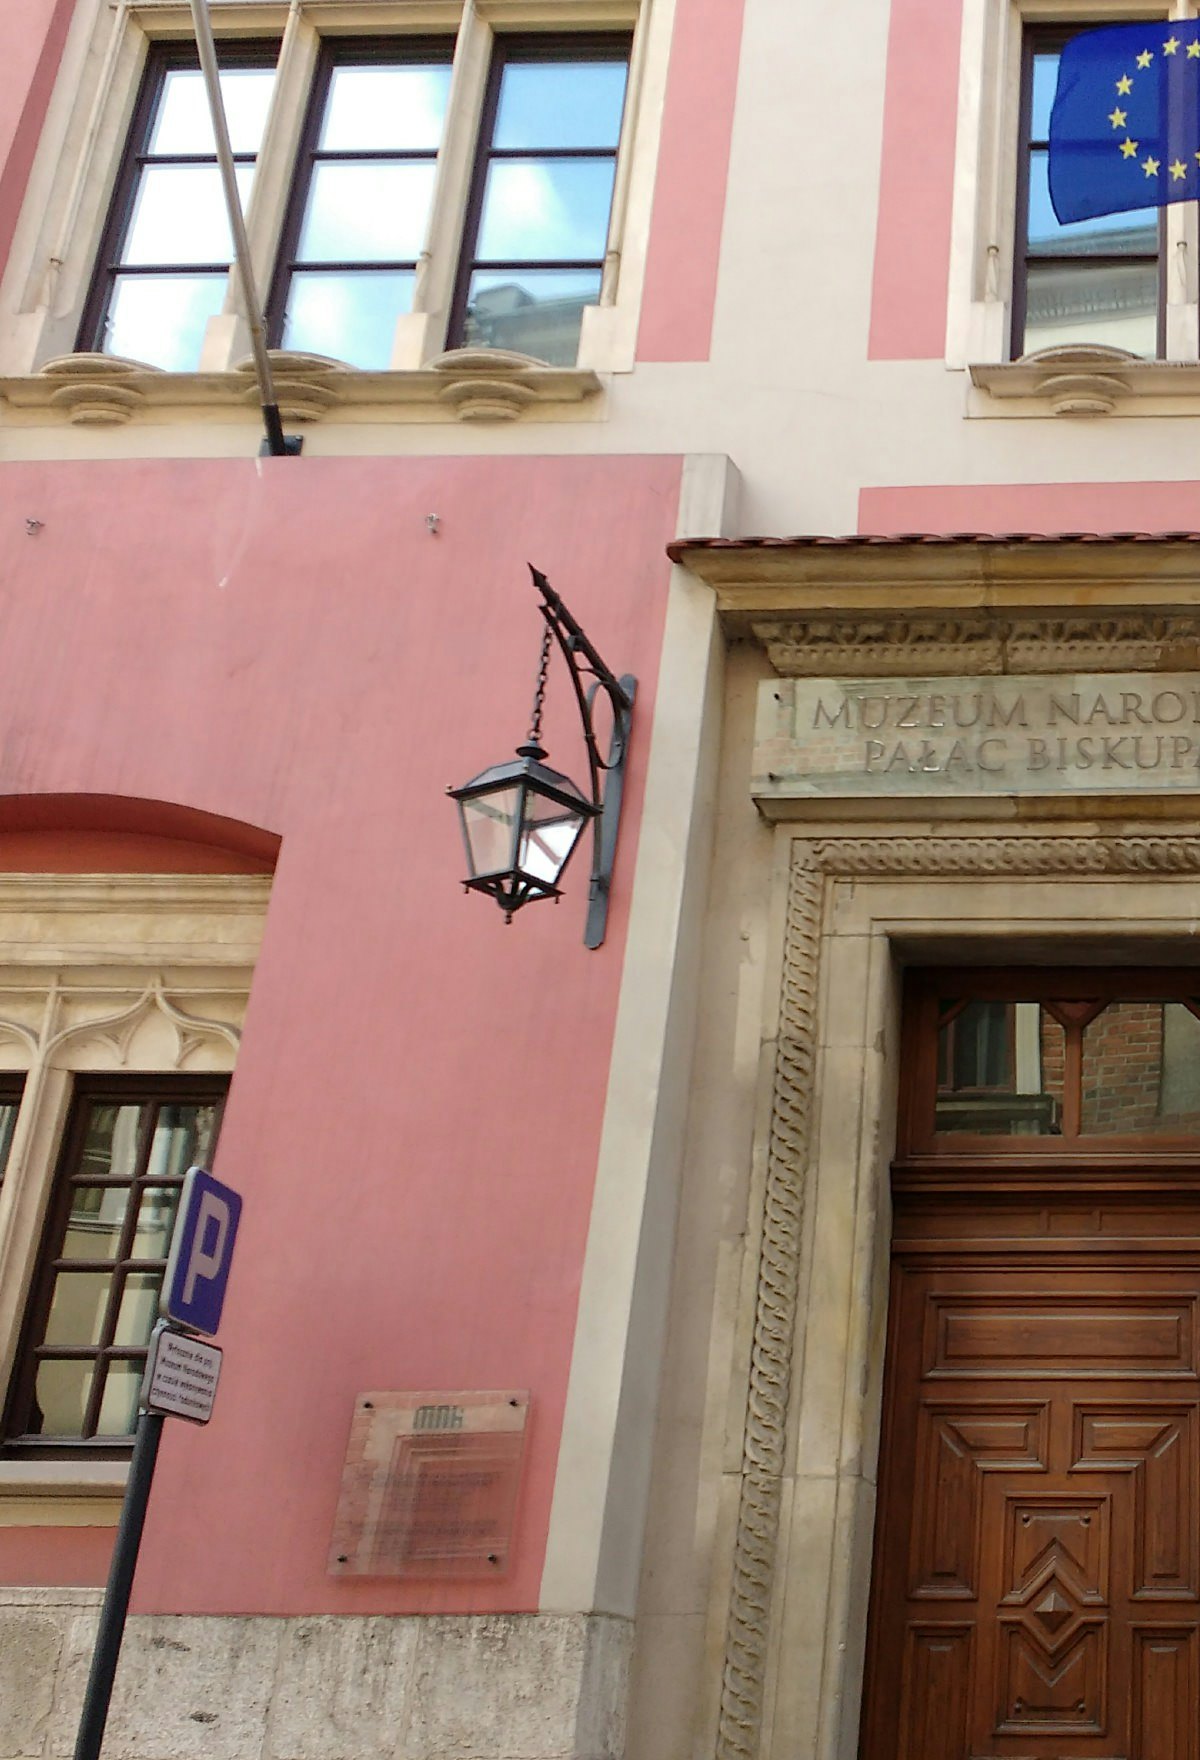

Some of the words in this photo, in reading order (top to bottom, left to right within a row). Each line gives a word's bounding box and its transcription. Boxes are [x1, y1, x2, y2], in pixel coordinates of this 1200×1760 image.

[812, 693, 1028, 730] MUZEUM
[864, 737, 1009, 774] PAŁAC
[181, 1189, 230, 1305] P
